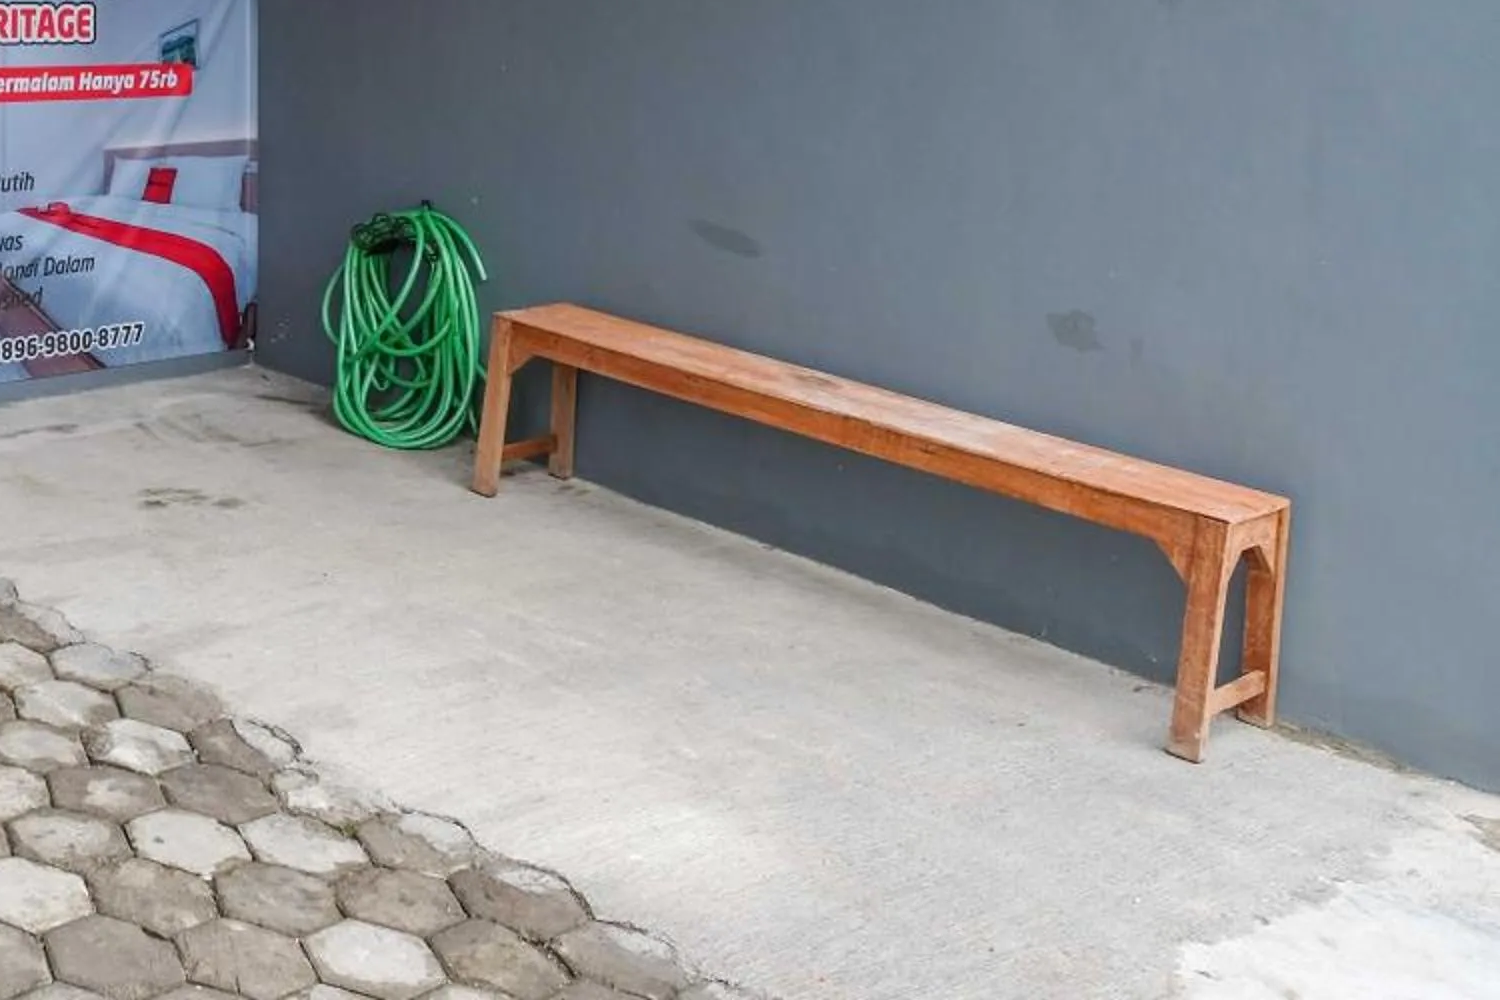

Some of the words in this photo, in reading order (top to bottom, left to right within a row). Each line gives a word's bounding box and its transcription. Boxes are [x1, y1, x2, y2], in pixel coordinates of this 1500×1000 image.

[77, 71, 134, 95] Hanya
[139, 69, 178, 90] 75rb
[43, 255, 95, 277] Dalam
